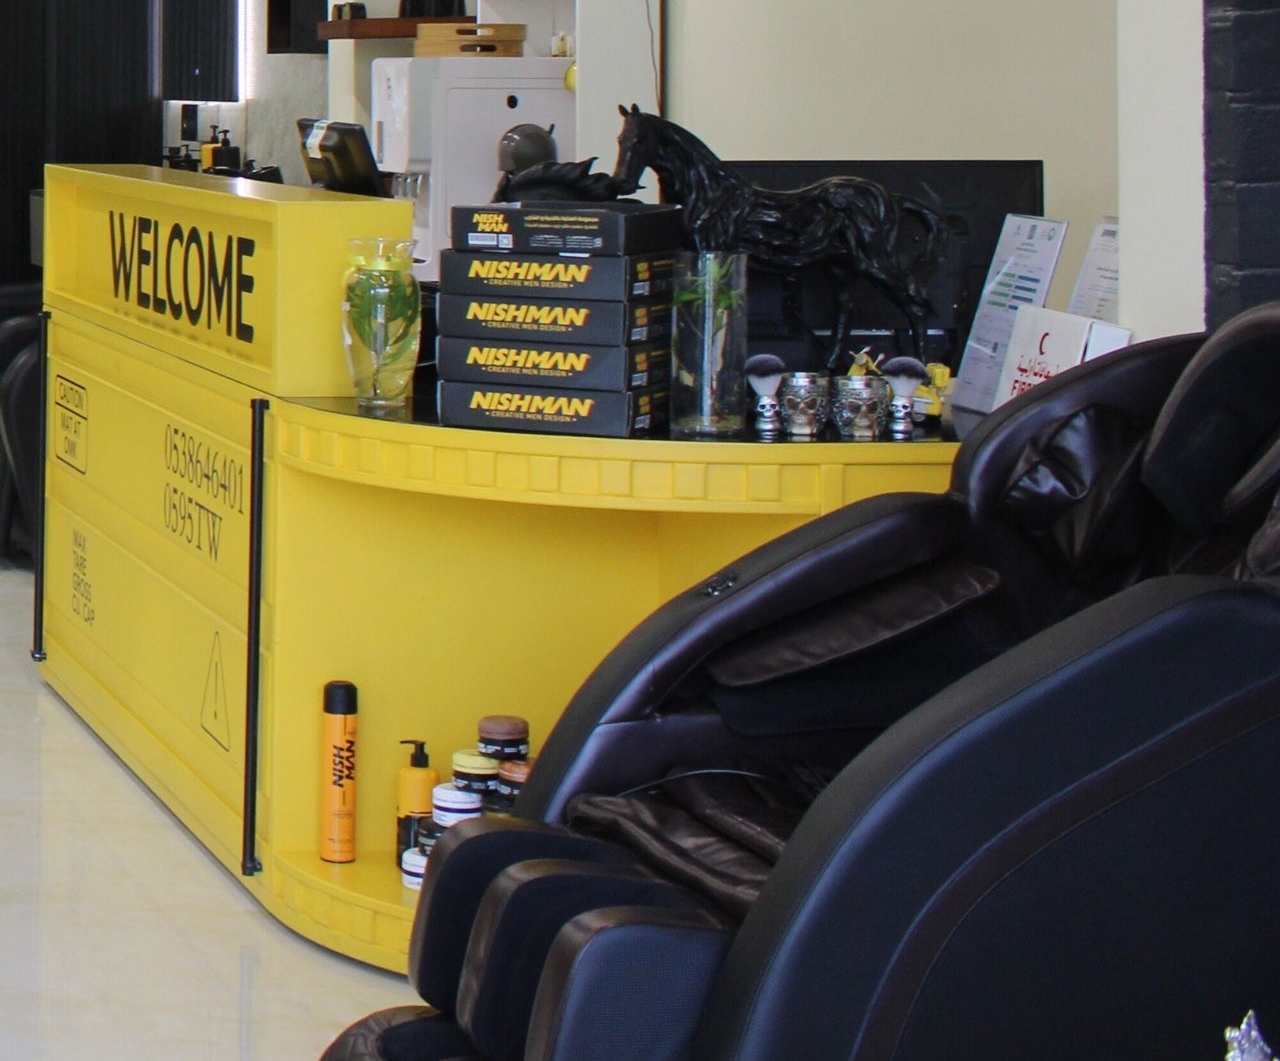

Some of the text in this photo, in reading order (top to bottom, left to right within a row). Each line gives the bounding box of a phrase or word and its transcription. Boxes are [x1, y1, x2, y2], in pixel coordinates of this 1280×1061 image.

[472, 213, 504, 224] NISH
[477, 223, 510, 233] MAN
[109, 210, 255, 344] WELCOME
[468, 260, 590, 283] NISHMAN
[489, 279, 522, 287] CREATIVE
[539, 281, 568, 289] DESIGN
[466, 302, 589, 327] NISHMAN
[487, 321, 520, 330] CREATIVE
[538, 324, 566, 332] DESIGN
[466, 346, 589, 372] NISHMAN
[487, 366, 520, 374] CREATIVE
[539, 369, 566, 377] DESIGN
[59, 382, 84, 410] CAUTION
[469, 391, 593, 417] NISHMAN
[491, 411, 523, 419] CREATIVE
[543, 414, 571, 422] DESIGN
[164, 424, 244, 515] 0538646401
[164, 483, 223, 562] 0595TW
[333, 744, 345, 788] NISH
[345, 739, 356, 781] MAN
